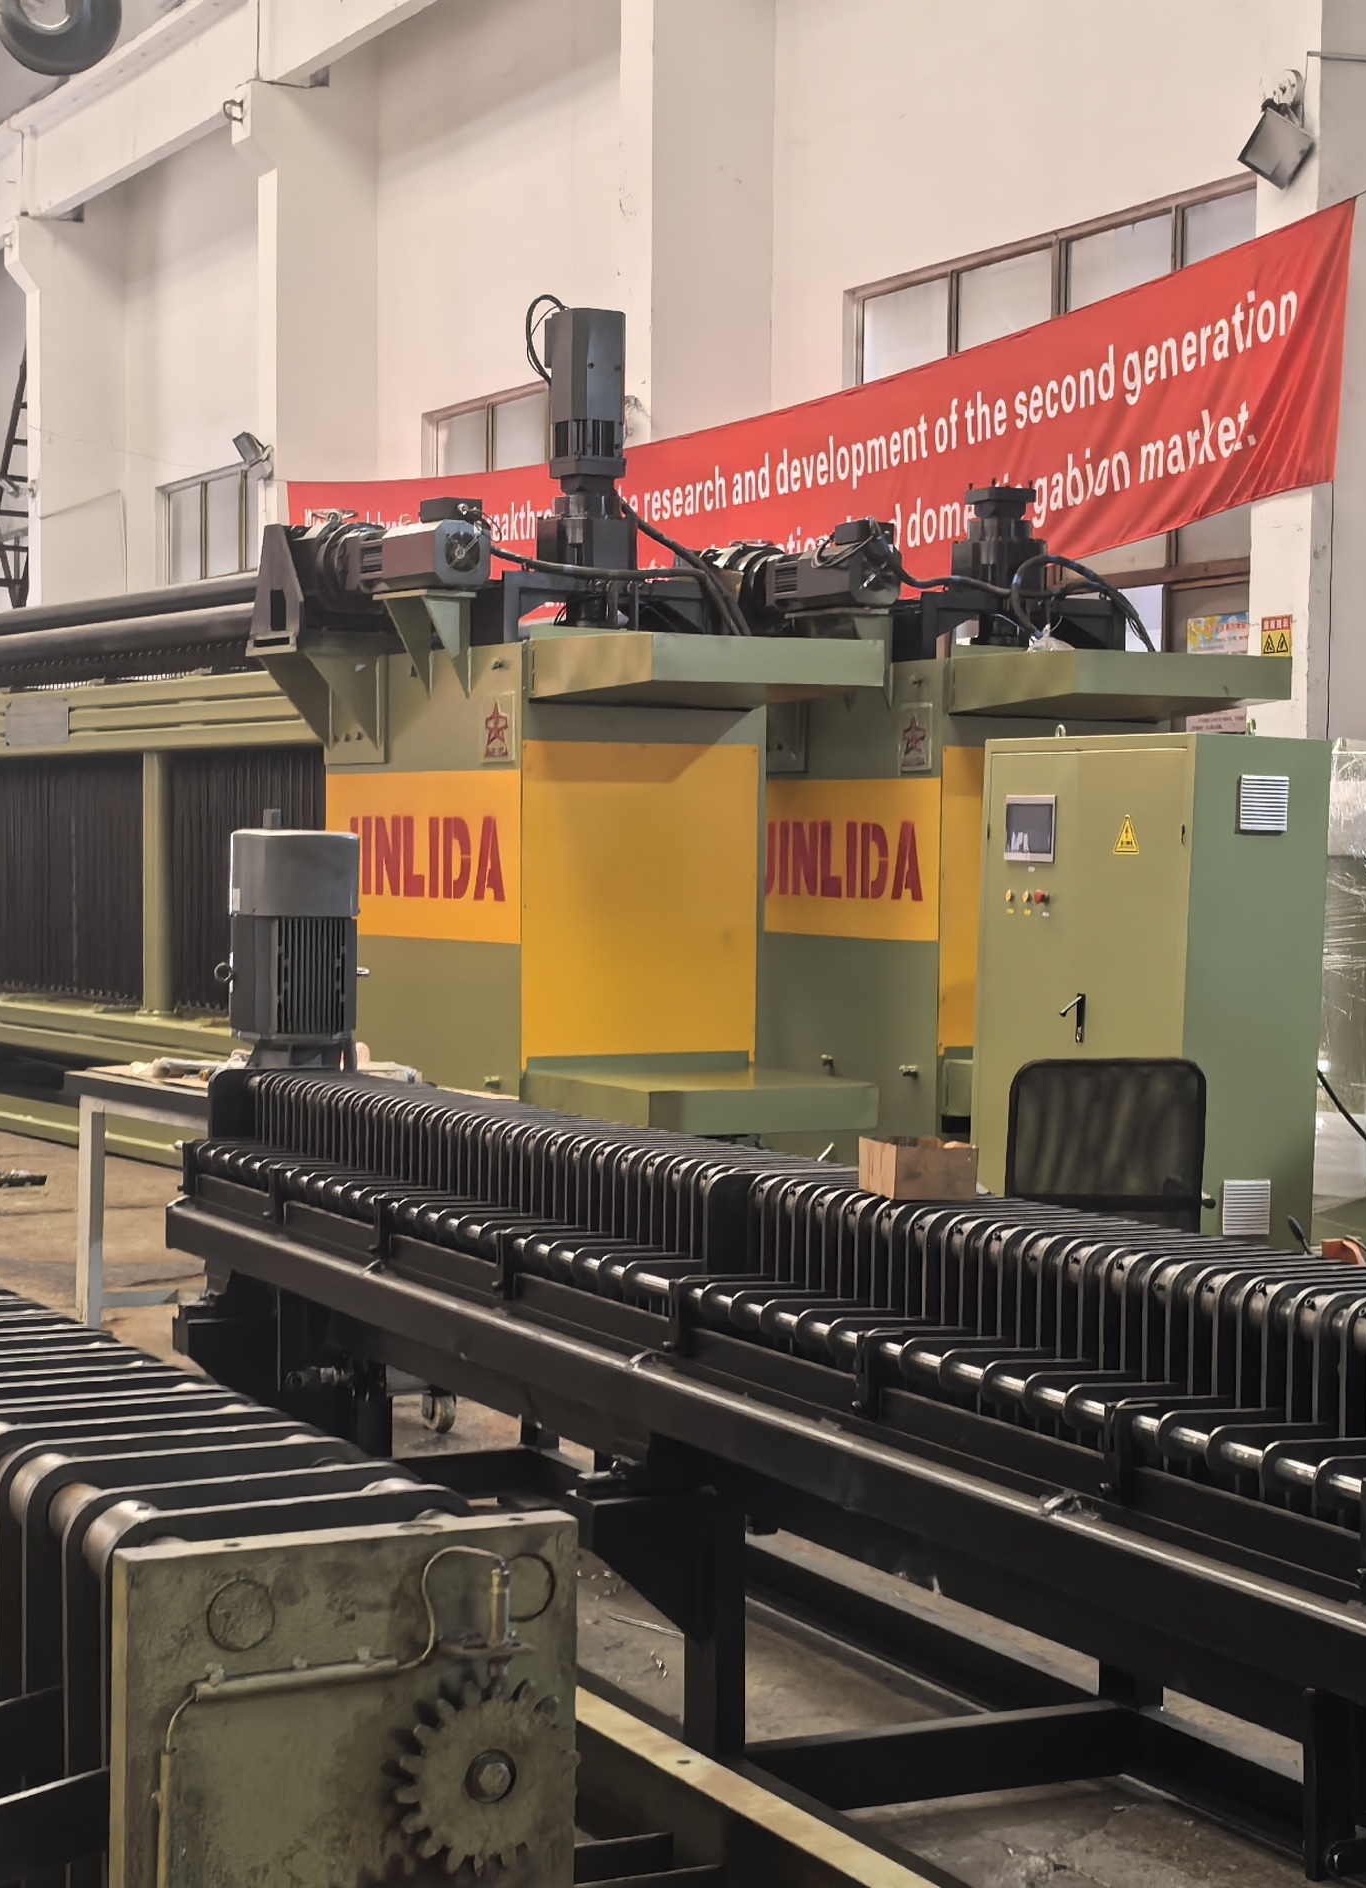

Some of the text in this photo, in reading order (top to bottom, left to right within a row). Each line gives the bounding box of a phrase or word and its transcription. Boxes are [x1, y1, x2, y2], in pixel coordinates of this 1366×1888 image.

[644, 467, 727, 523] research
[732, 455, 771, 506] and
[776, 415, 928, 488] development
[935, 399, 959, 452] of
[965, 391, 1007, 443] the
[1015, 345, 1115, 427] second
[1123, 290, 1298, 404] generation
[1032, 448, 1130, 529] gabion
[1139, 401, 1257, 484] market.
[350, 816, 506, 902] INLIDA
